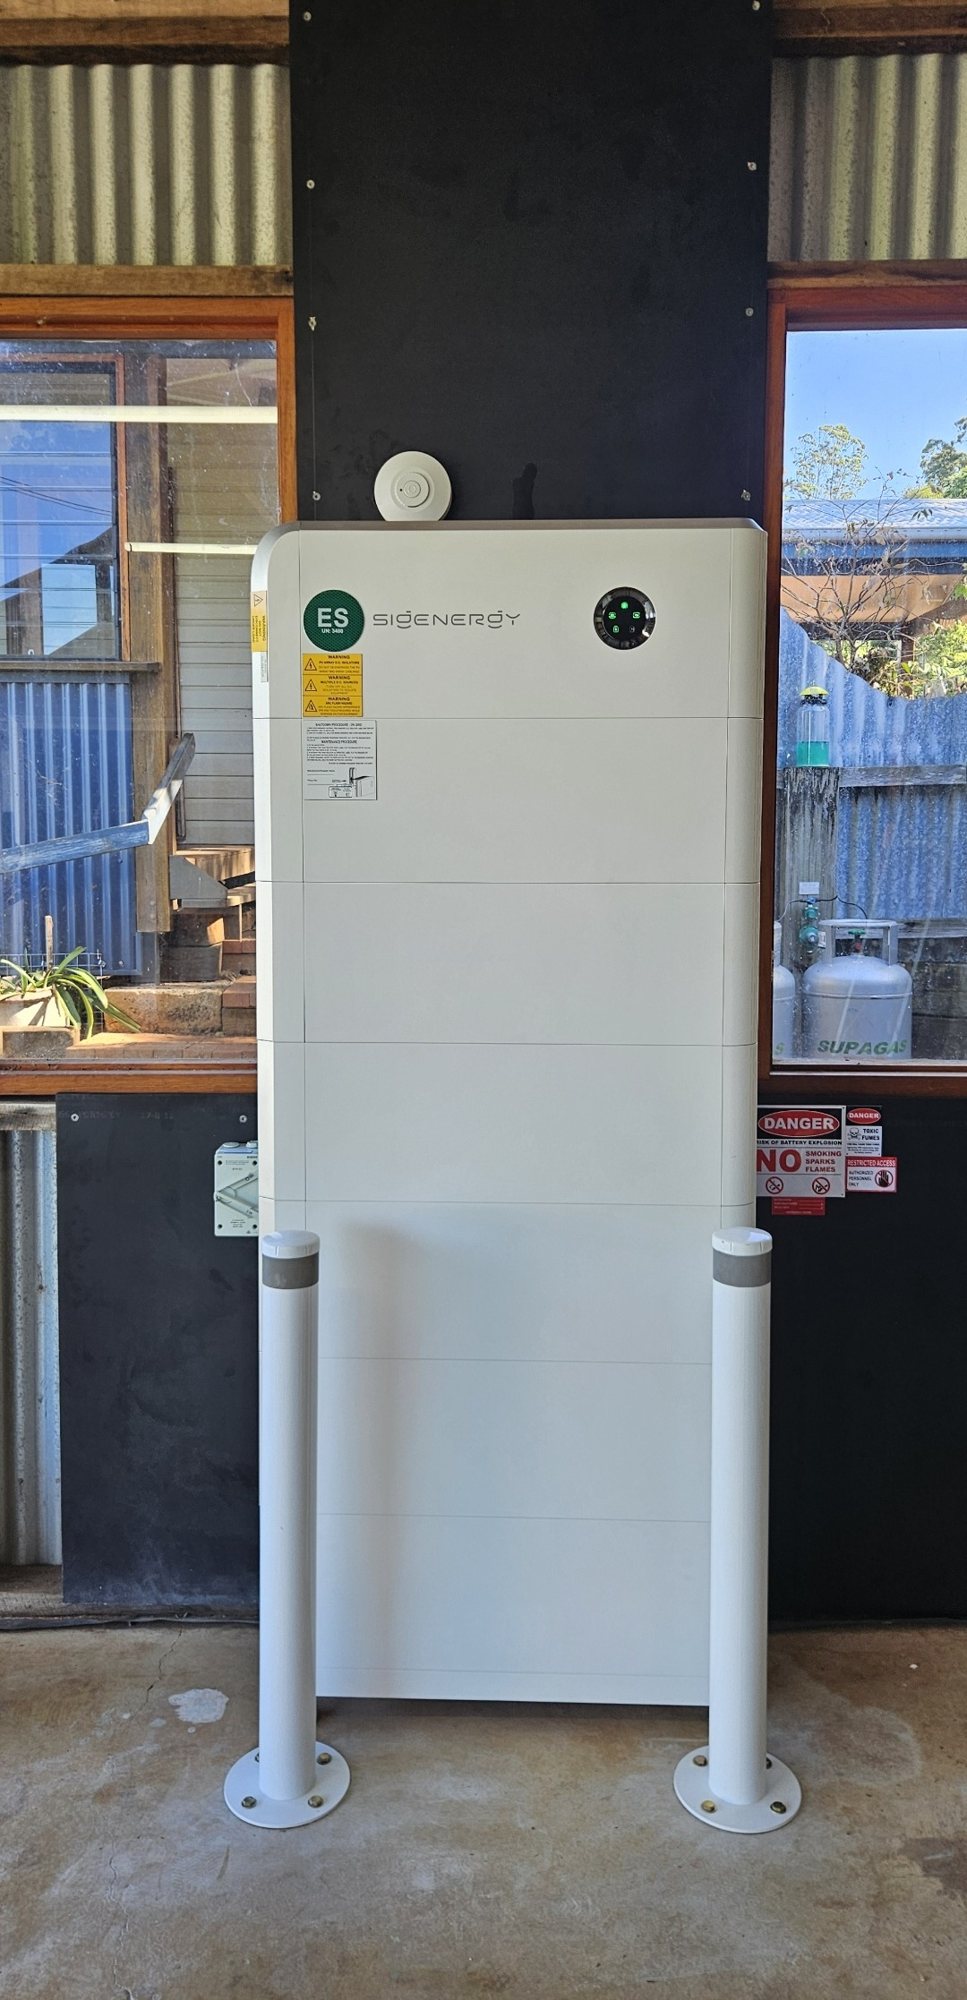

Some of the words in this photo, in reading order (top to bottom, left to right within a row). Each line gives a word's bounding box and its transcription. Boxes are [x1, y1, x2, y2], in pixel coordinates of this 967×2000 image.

[317, 607, 349, 628] ES
[373, 610, 521, 629] SIGENERGY
[817, 1039, 907, 1056] SUPAGAS
[764, 1117, 834, 1130] DANGER
[757, 1149, 801, 1172] NO
